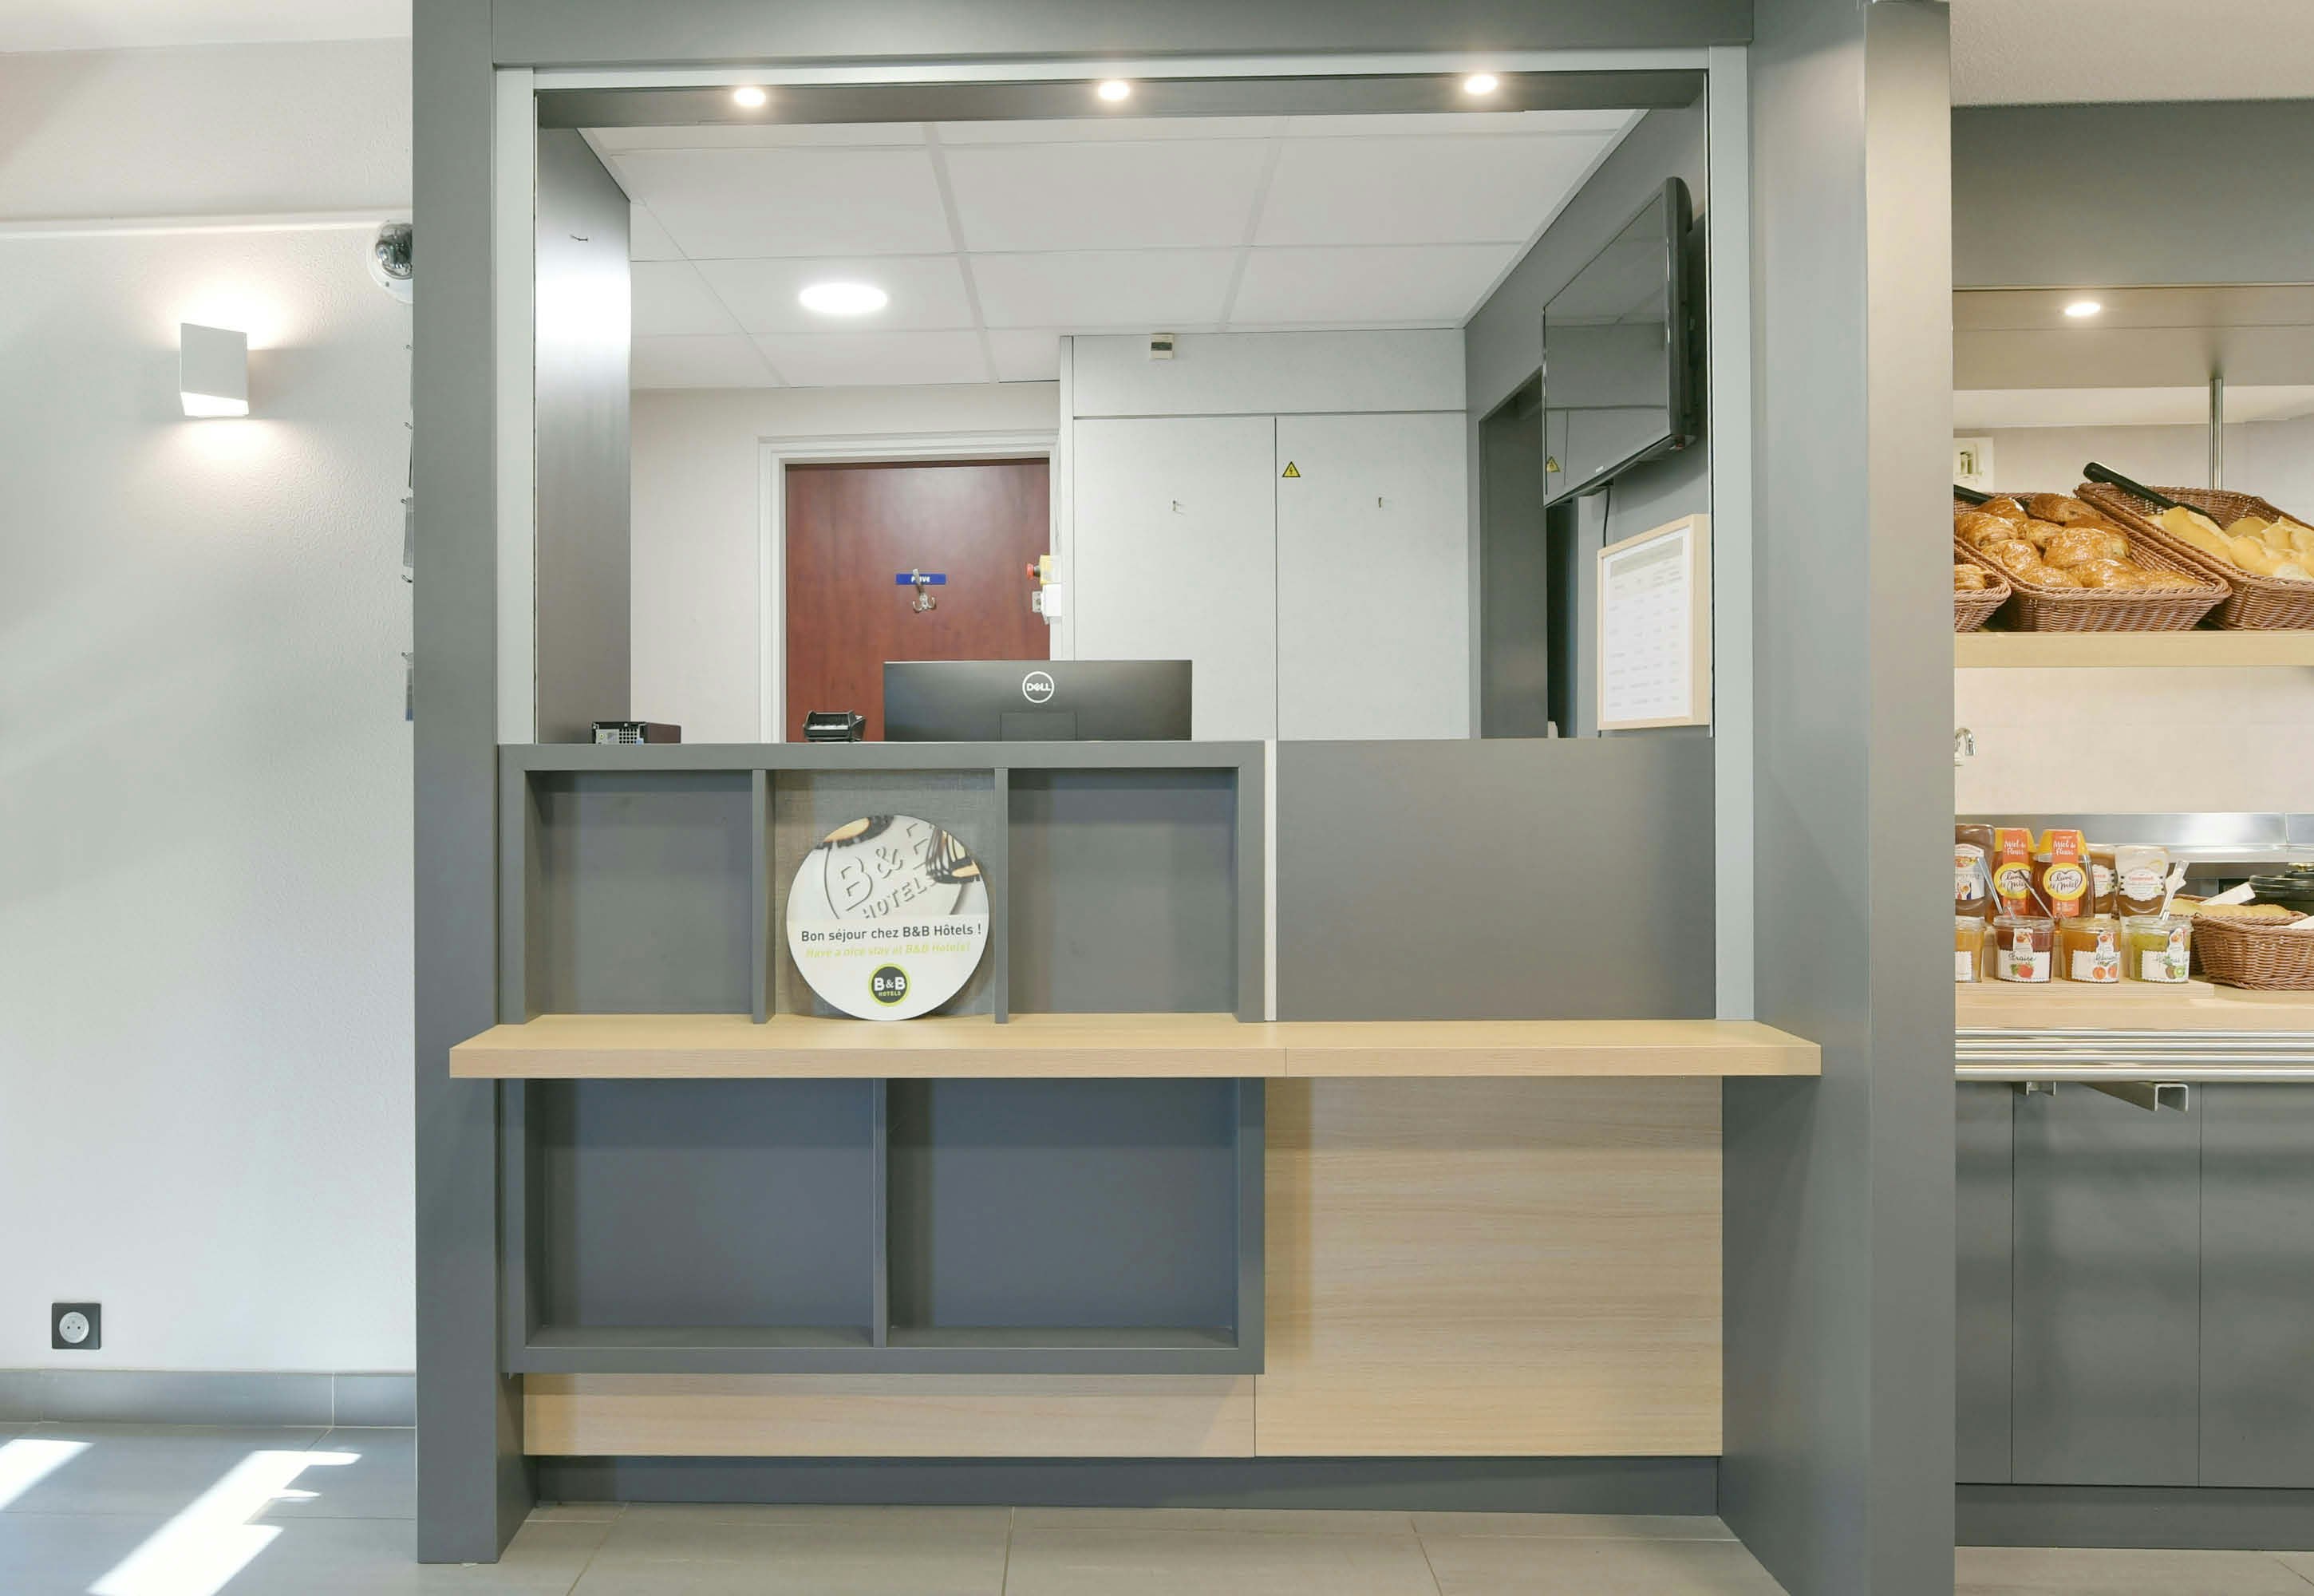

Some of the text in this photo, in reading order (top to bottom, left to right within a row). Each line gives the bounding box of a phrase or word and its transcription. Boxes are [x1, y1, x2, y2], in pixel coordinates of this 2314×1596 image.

[1026, 682, 1051, 692] DELL
[2004, 839, 2019, 848] Miel
[801, 930, 825, 942] Bon
[829, 929, 868, 942] séjour
[871, 927, 899, 939] chez
[903, 926, 930, 938] B&B
[934, 923, 973, 936] Hôtels
[806, 948, 832, 958] Have
[843, 947, 866, 957] nice
[868, 946, 890, 957] stay
[893, 945, 902, 954] at
[906, 943, 929, 954] B&B
[874, 976, 906, 991] B&B
